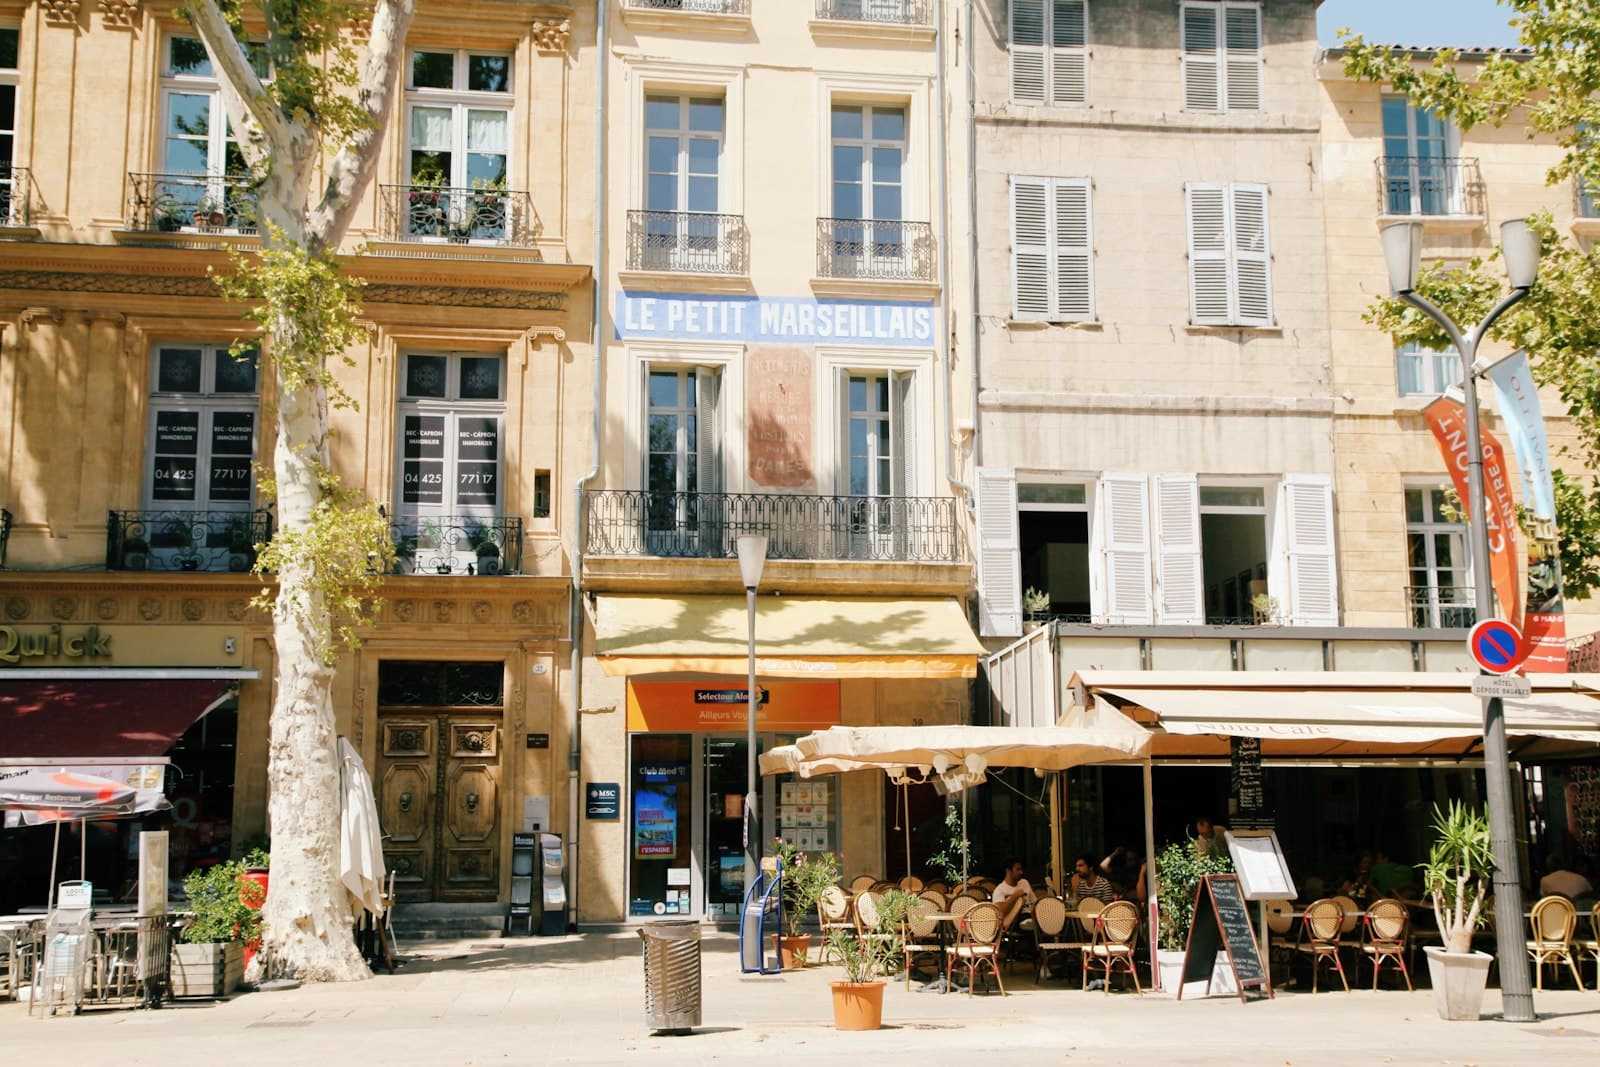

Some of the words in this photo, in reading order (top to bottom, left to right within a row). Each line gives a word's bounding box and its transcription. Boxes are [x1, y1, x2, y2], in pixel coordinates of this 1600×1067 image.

[625, 298, 656, 331] LE
[668, 300, 747, 334] PETIT
[760, 302, 931, 340] MARSEILLAIS
[155, 469, 169, 479] 04
[173, 470, 195, 480] 425
[213, 469, 234, 479] 771
[405, 473, 419, 483] 04
[421, 473, 442, 484] 425
[460, 474, 480, 484] 771
[0, 624, 112, 663] Quick
[697, 691, 734, 701] Selectour
[698, 711, 731, 720] Ailleurs
[639, 766, 657, 776] Club
[658, 766, 677, 776] Med
